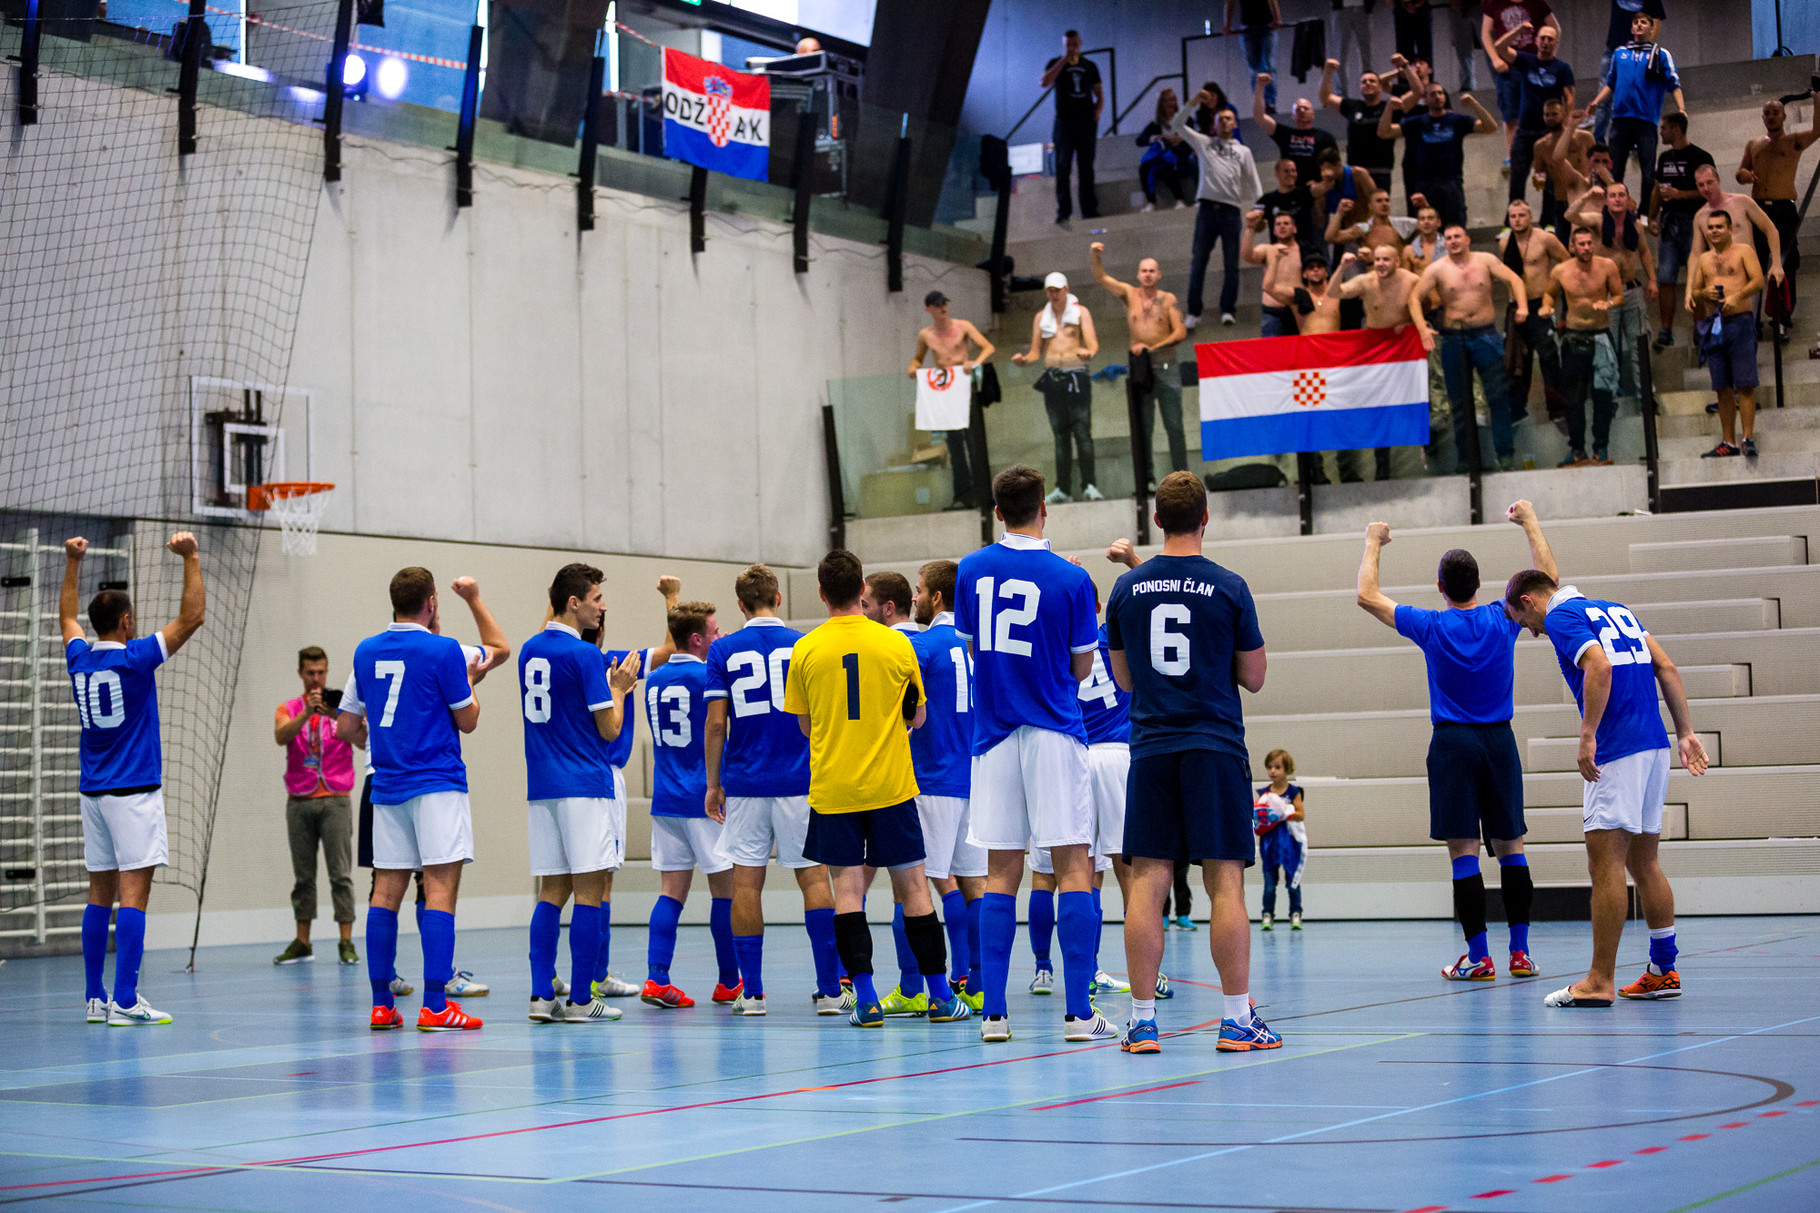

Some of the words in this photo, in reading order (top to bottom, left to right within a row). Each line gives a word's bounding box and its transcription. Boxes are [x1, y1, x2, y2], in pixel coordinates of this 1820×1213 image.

[976, 576, 1041, 657] 12
[1132, 579, 1181, 596] PONOSNI
[1183, 577, 1215, 597] ČLAN
[1150, 603, 1191, 676] 6
[1585, 606, 1652, 666] 29
[74, 669, 126, 729] 10
[375, 660, 406, 728] 7
[524, 657, 551, 724] 8
[842, 653, 861, 721] 1
[950, 647, 975, 713] 1
[648, 685, 692, 748] 13
